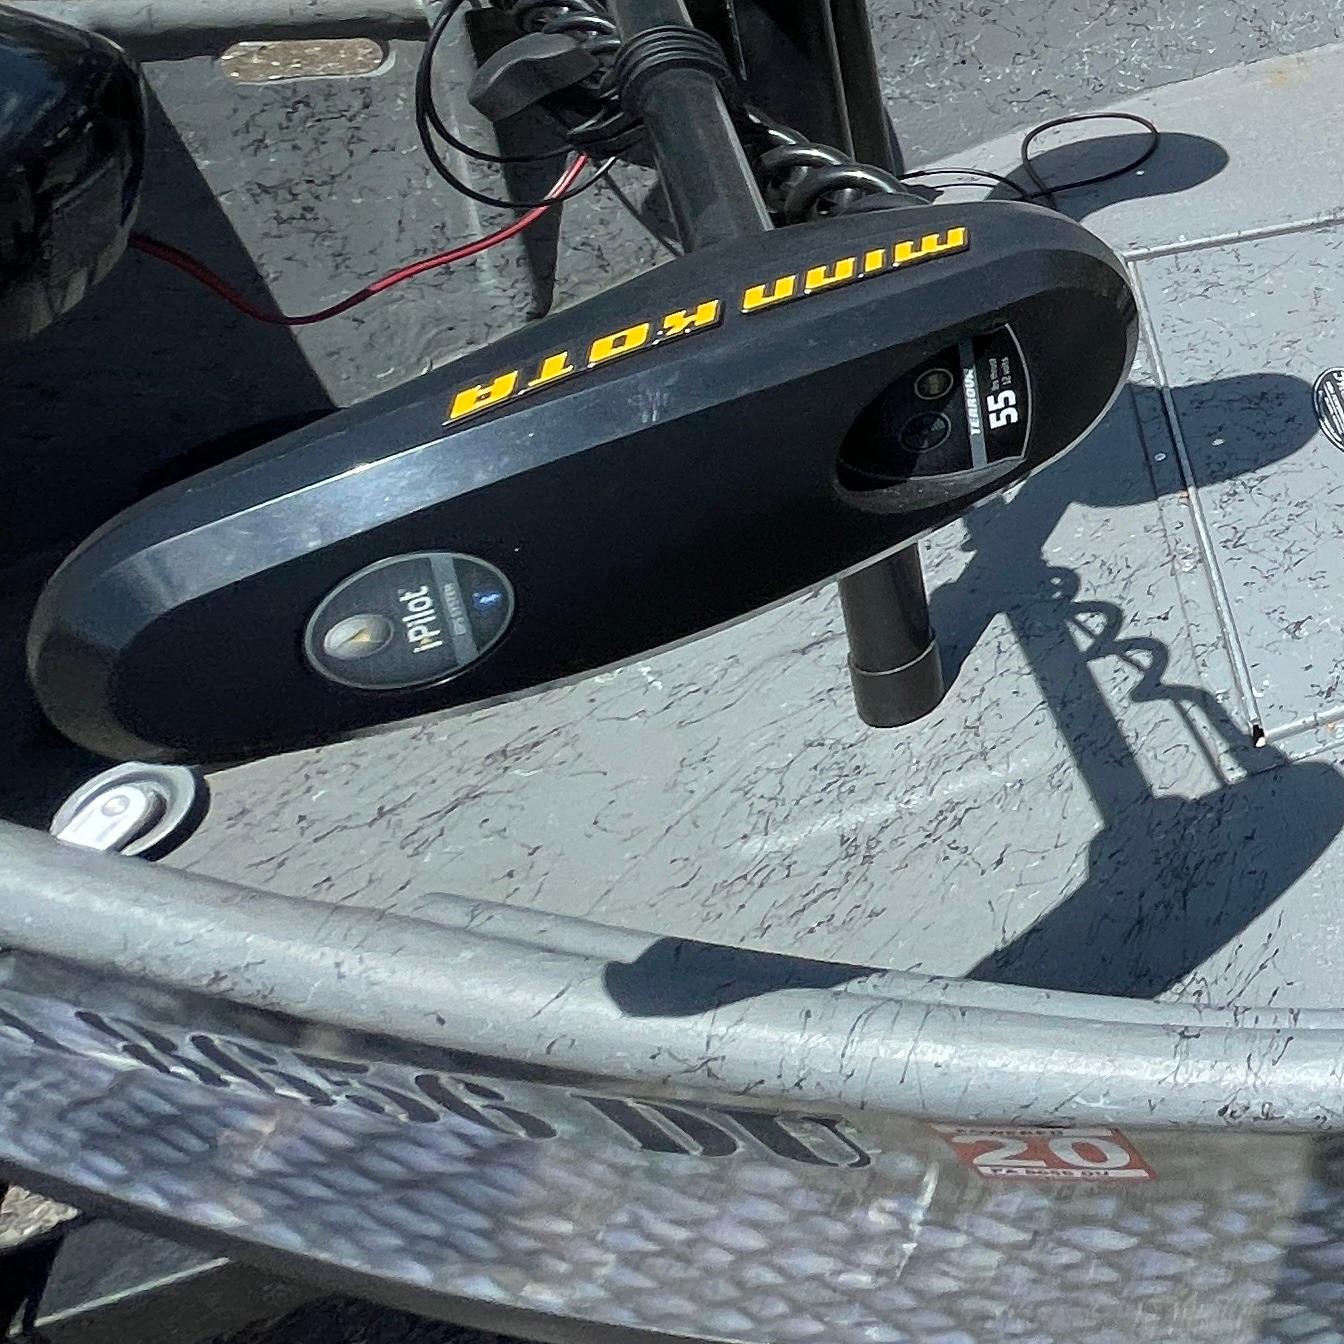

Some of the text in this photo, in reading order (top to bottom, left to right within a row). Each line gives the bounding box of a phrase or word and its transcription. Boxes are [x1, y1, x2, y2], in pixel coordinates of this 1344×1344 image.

[446, 298, 721, 423] KOTA
[986, 389, 1019, 430] 55
[568, 1092, 874, 1168] DU
[952, 1135, 1131, 1168] 20
